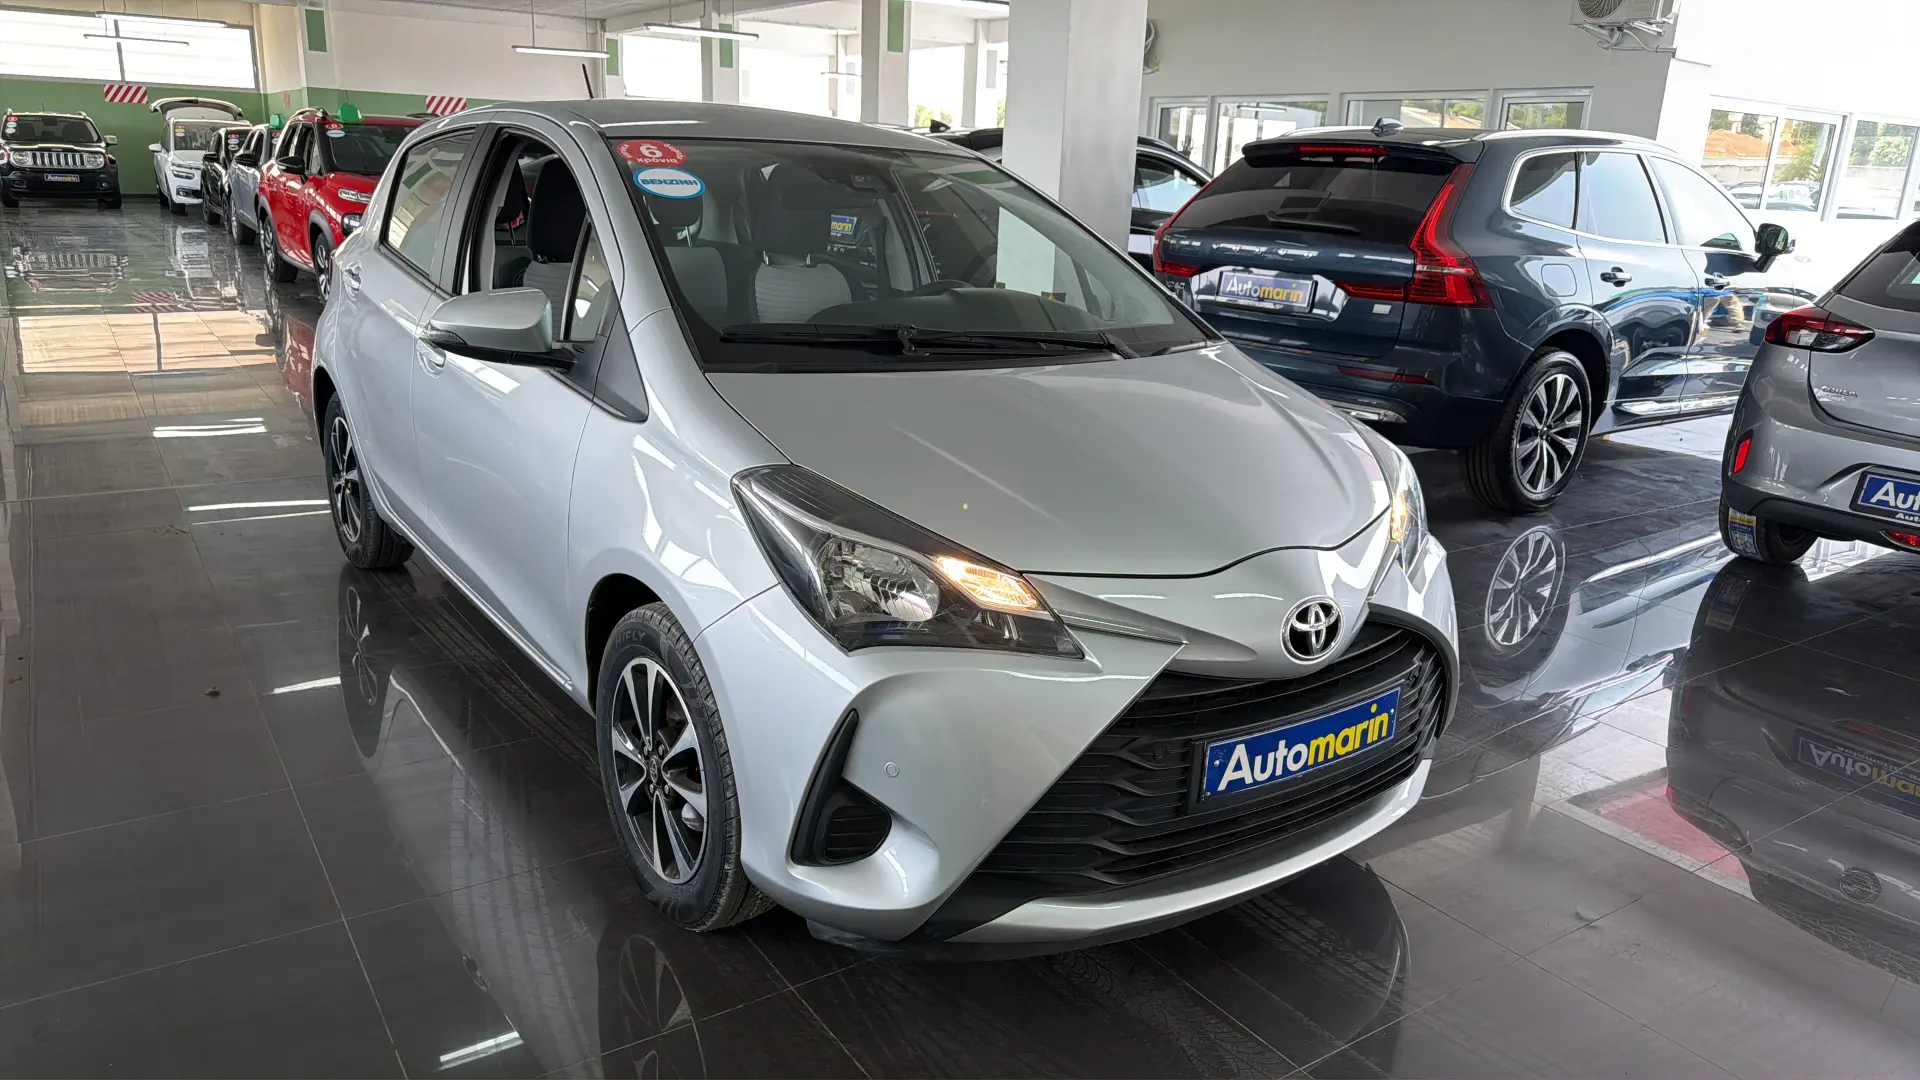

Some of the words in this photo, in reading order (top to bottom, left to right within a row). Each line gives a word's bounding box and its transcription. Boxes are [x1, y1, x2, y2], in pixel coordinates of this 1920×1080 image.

[640, 145, 662, 157] 6
[1226, 276, 1304, 302] Automarin
[616, 630, 646, 648] HIFLY
[1217, 703, 1389, 791] Automarin
